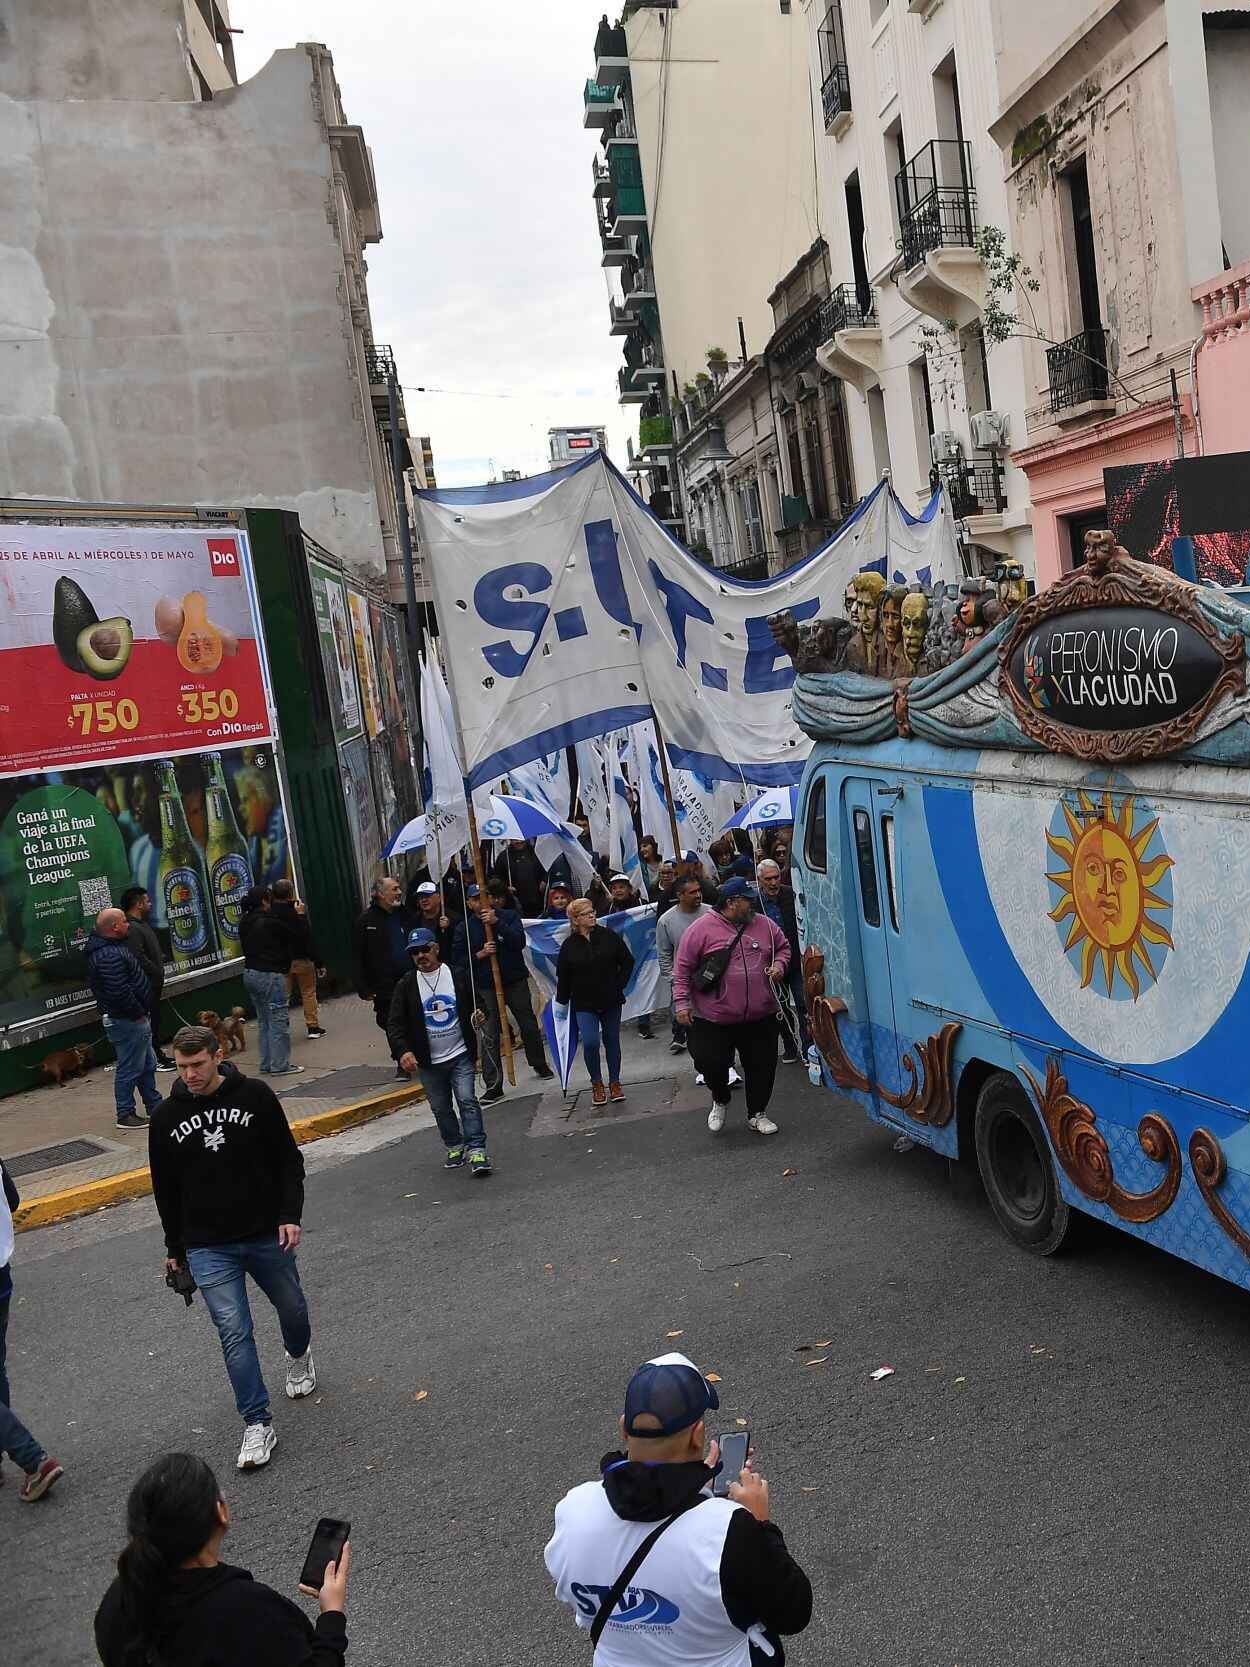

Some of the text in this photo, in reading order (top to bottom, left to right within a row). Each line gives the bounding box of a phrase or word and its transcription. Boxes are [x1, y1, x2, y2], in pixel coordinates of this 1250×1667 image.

[14, 551, 29, 561] DE
[32, 551, 64, 560] ABRIL
[67, 551, 81, 560] AL
[84, 549, 142, 560] MIÉRCOLES
[144, 551, 149, 560] 1
[151, 551, 164, 559] DE
[167, 551, 194, 559] MAYO
[1050, 627, 1178, 674] PERONISMO
[70, 693, 88, 701] PALTA
[94, 690, 116, 698] UNIDAD
[207, 727, 222, 737] Con
[242, 722, 264, 733] llegás
[16, 808, 68, 825] Ganá un
[19, 824, 48, 839] viaje
[59, 820, 70, 833] la
[71, 815, 96, 830] final
[23, 833, 88, 856] de la UEFA
[25, 849, 91, 870] Champions
[28, 868, 75, 886] League.
[170, 1108, 254, 1144] ZOO YORK
